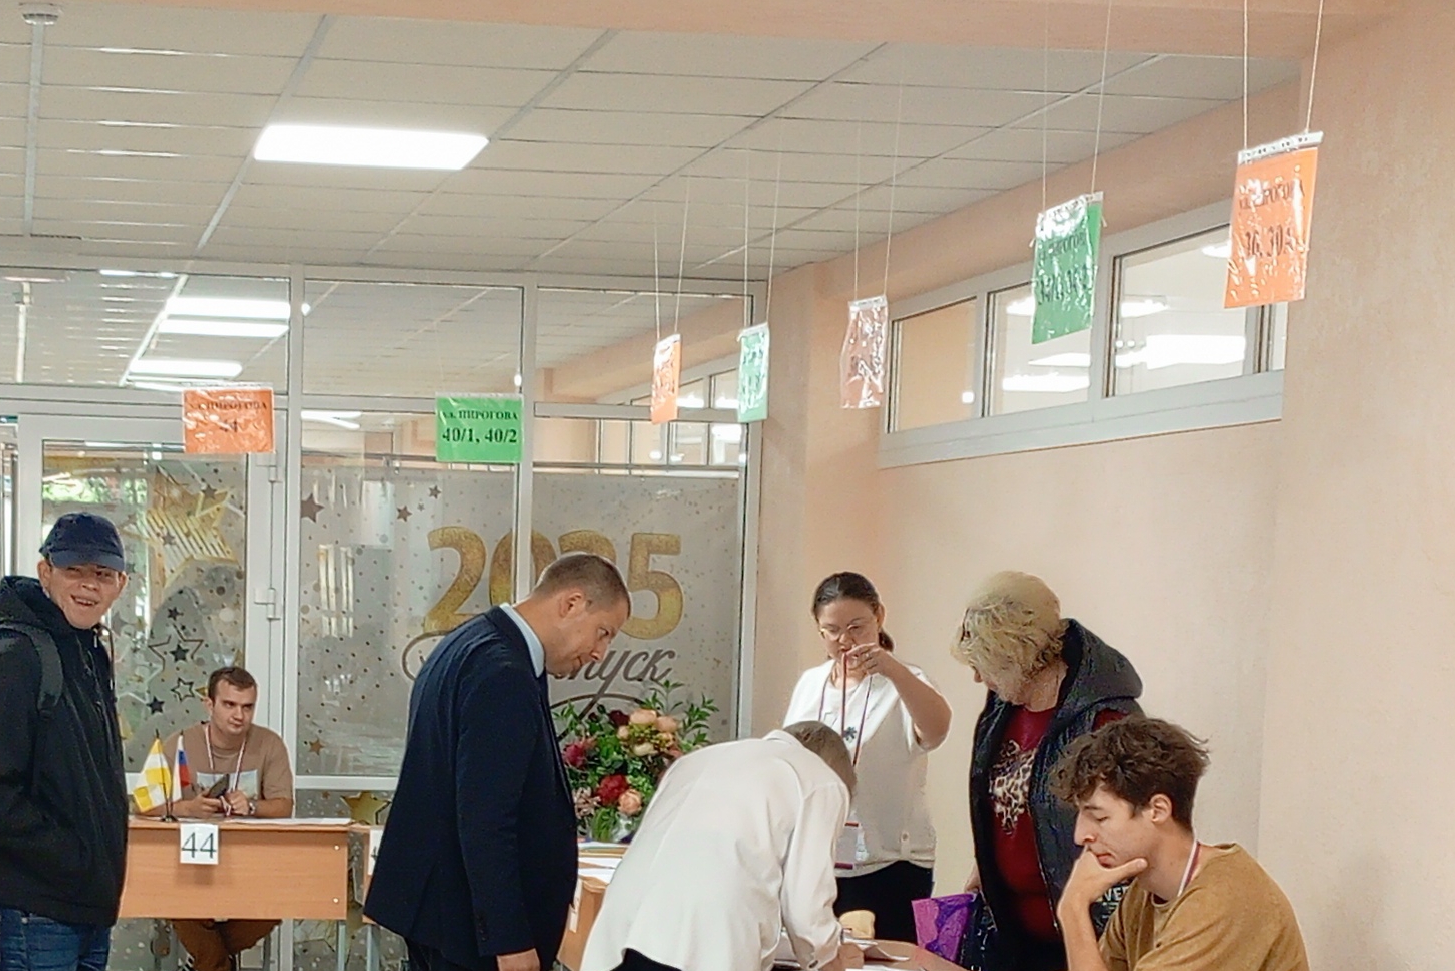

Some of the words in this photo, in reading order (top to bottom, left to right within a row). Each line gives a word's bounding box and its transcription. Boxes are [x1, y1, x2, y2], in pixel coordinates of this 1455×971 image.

[458, 409, 518, 420] ПИРОГОВА
[442, 427, 480, 444] 40/1,
[485, 428, 517, 443] 40/2
[181, 832, 217, 859] 44
